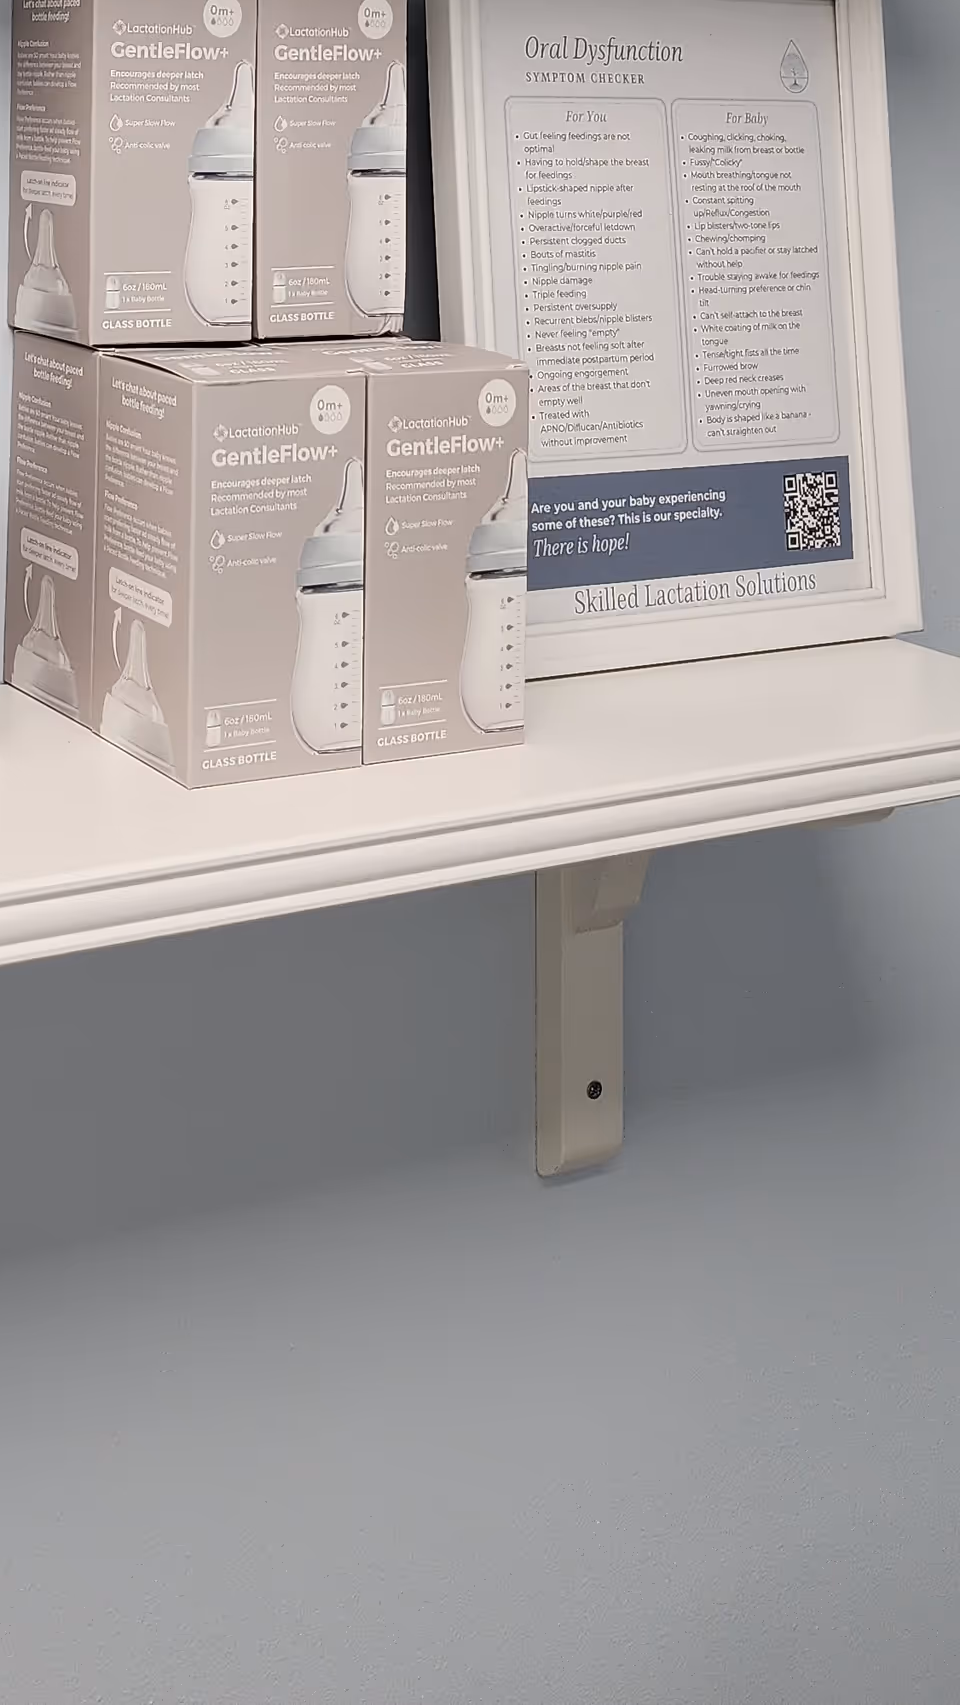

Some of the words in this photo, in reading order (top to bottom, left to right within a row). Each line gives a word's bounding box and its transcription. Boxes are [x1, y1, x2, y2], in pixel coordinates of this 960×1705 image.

[210, 5, 234, 16] 0m+
[364, 7, 386, 19] 0m+
[110, 42, 228, 61] GentleFlow+
[274, 45, 382, 63] GentleFlow+
[526, 36, 568, 59] Oral
[574, 37, 683, 66] Dysfunction
[110, 70, 155, 80] Encourages
[157, 71, 182, 81] deeper
[185, 71, 204, 79] latch
[526, 72, 585, 83] SYMPTOM
[591, 73, 644, 84] CHECKER
[110, 82, 168, 91] Recommended
[171, 82, 180, 92] by
[182, 83, 200, 91] most
[110, 95, 144, 103] Lactation
[146, 95, 190, 103] Consultants
[566, 111, 584, 122] For
[587, 111, 607, 122] You
[726, 113, 742, 124] For
[745, 113, 768, 127] Baby
[523, 132, 538, 140] Gut
[540, 132, 566, 141] feeling
[568, 132, 601, 142] feedings
[617, 133, 630, 141] not
[688, 134, 725, 142] Coughing,
[757, 134, 786, 143] choking,
[524, 145, 554, 154] optimal
[689, 146, 715, 154] leaking
[734, 146, 751, 154] from
[525, 158, 552, 167] Having
[555, 159, 563, 167] to
[566, 159, 608, 168] hold/shape
[626, 159, 649, 167] breast
[529, 211, 554, 220] Nipple
[578, 209, 642, 219] white/purple/red
[530, 237, 569, 245] Persistent
[571, 237, 602, 245] clogged
[717, 247, 732, 255] hold
[741, 247, 766, 256] pacifier
[777, 247, 791, 255] stay
[270, 313, 298, 323] GLASS
[300, 312, 334, 321] BOTTLE
[102, 319, 133, 329] GLASS
[136, 319, 172, 328] BOTTLE
[126, 384, 139, 393] chat
[140, 388, 157, 400] about
[158, 394, 177, 407] paced
[485, 392, 509, 404] 0m+
[317, 400, 342, 411] 0m+
[386, 436, 504, 457] GentleFlow+
[211, 444, 337, 468] GentleFlow+
[531, 503, 551, 514] Are
[554, 501, 574, 514] you
[578, 499, 598, 510] and
[601, 498, 627, 511] your
[630, 494, 655, 508] baby
[658, 489, 726, 505] experiencing
[531, 520, 563, 532] some
[566, 517, 577, 529] of
[579, 514, 615, 527] these?
[618, 513, 640, 525] This
[643, 512, 651, 523] is
[654, 511, 671, 522] our
[674, 506, 723, 523] specialty.
[533, 538, 574, 559] There
[577, 537, 588, 555] is
[591, 532, 629, 556] hope!
[574, 586, 639, 615] Skilled
[645, 580, 730, 607] Lactation
[736, 571, 816, 598] Solutions
[377, 736, 409, 747] GLASS
[411, 731, 447, 743] BOTTLE
[202, 757, 236, 770] GLASS
[238, 752, 277, 766] BOTTLE
